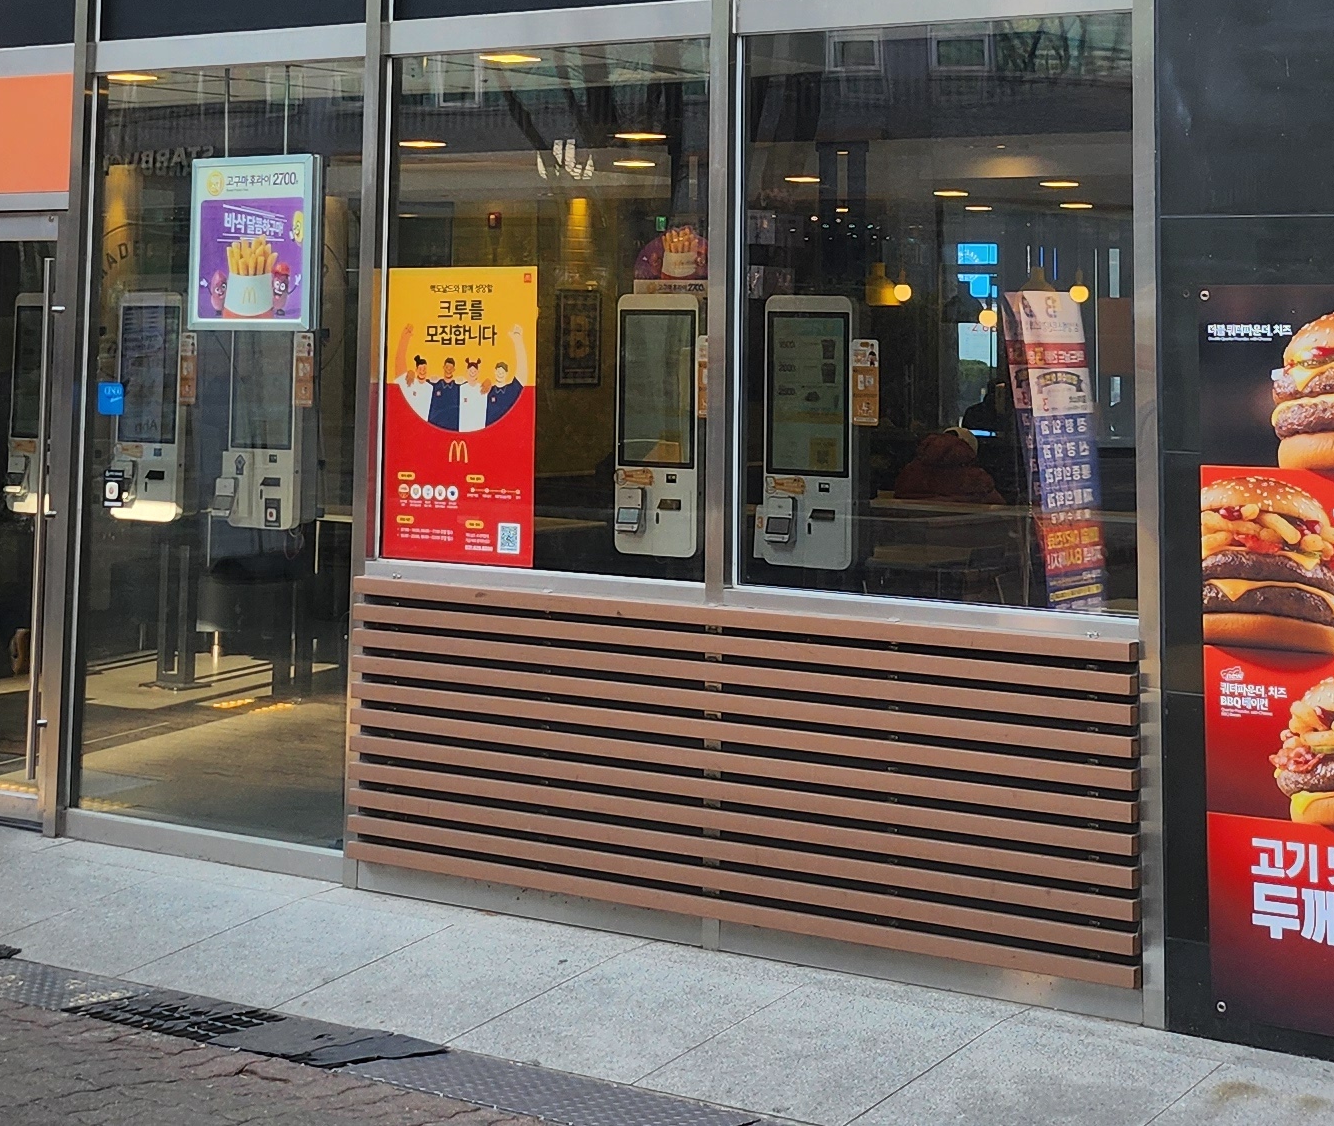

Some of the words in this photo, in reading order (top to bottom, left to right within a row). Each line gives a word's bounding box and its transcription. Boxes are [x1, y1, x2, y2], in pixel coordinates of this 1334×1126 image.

[226, 175, 248, 187] 고구마
[249, 174, 271, 187] 후라이
[430, 284, 460, 294] 맥도날드와
[461, 284, 474, 294] 함께
[475, 284, 494, 294] 성장할
[438, 299, 484, 321] 크루를
[425, 324, 498, 346] 모집합니다
[1273, 324, 1293, 337] 치즈
[1268, 686, 1288, 699] 치즈
[1220, 696, 1242, 709] BBQ
[1242, 697, 1269, 711] 베이컨
[1251, 837, 1319, 883] 고기
